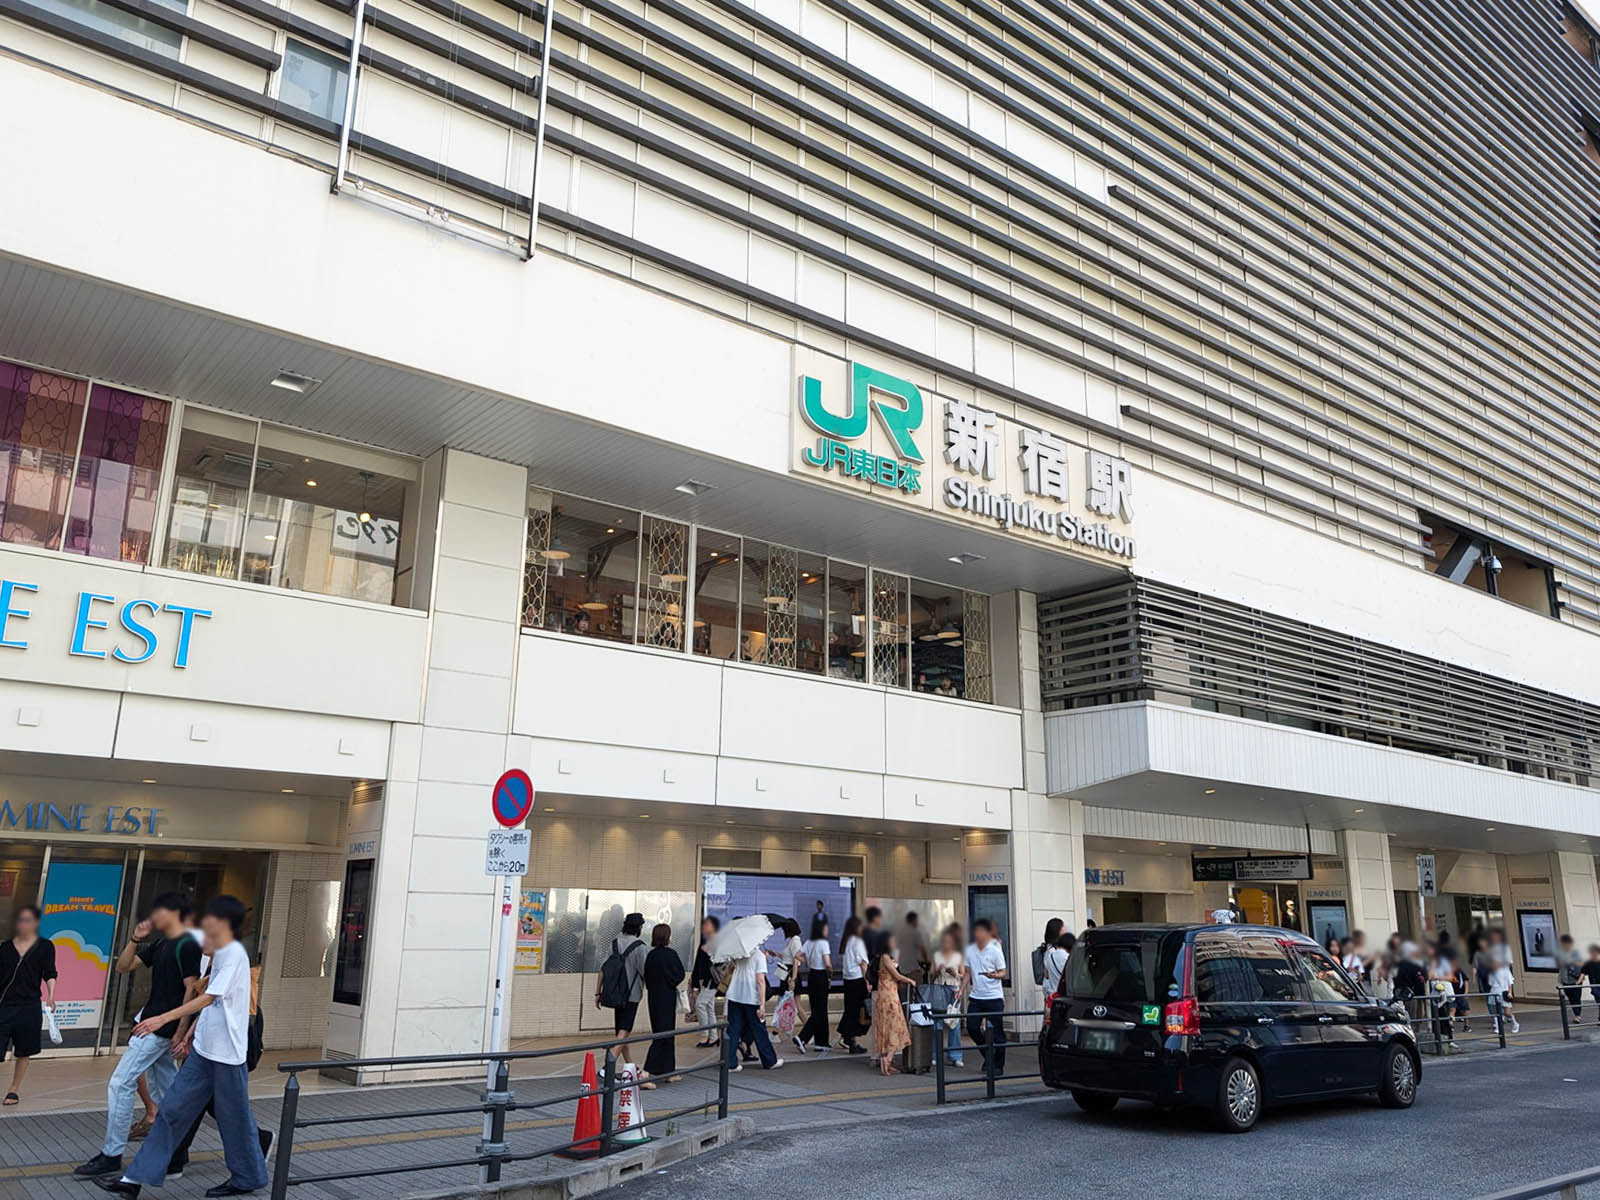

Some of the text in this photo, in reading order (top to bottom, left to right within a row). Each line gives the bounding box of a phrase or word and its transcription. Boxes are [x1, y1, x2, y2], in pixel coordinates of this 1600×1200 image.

[799, 361, 925, 464] JR
[802, 437, 922, 494] JR東日本
[943, 401, 1135, 524] 新宿駅
[943, 476, 1137, 559] Shinjuku Station
[68, 591, 214, 670] EST
[105, 804, 166, 835] EST
[1420, 857, 1434, 869] TAXI
[44, 903, 116, 916] DREAM TRAVEL
